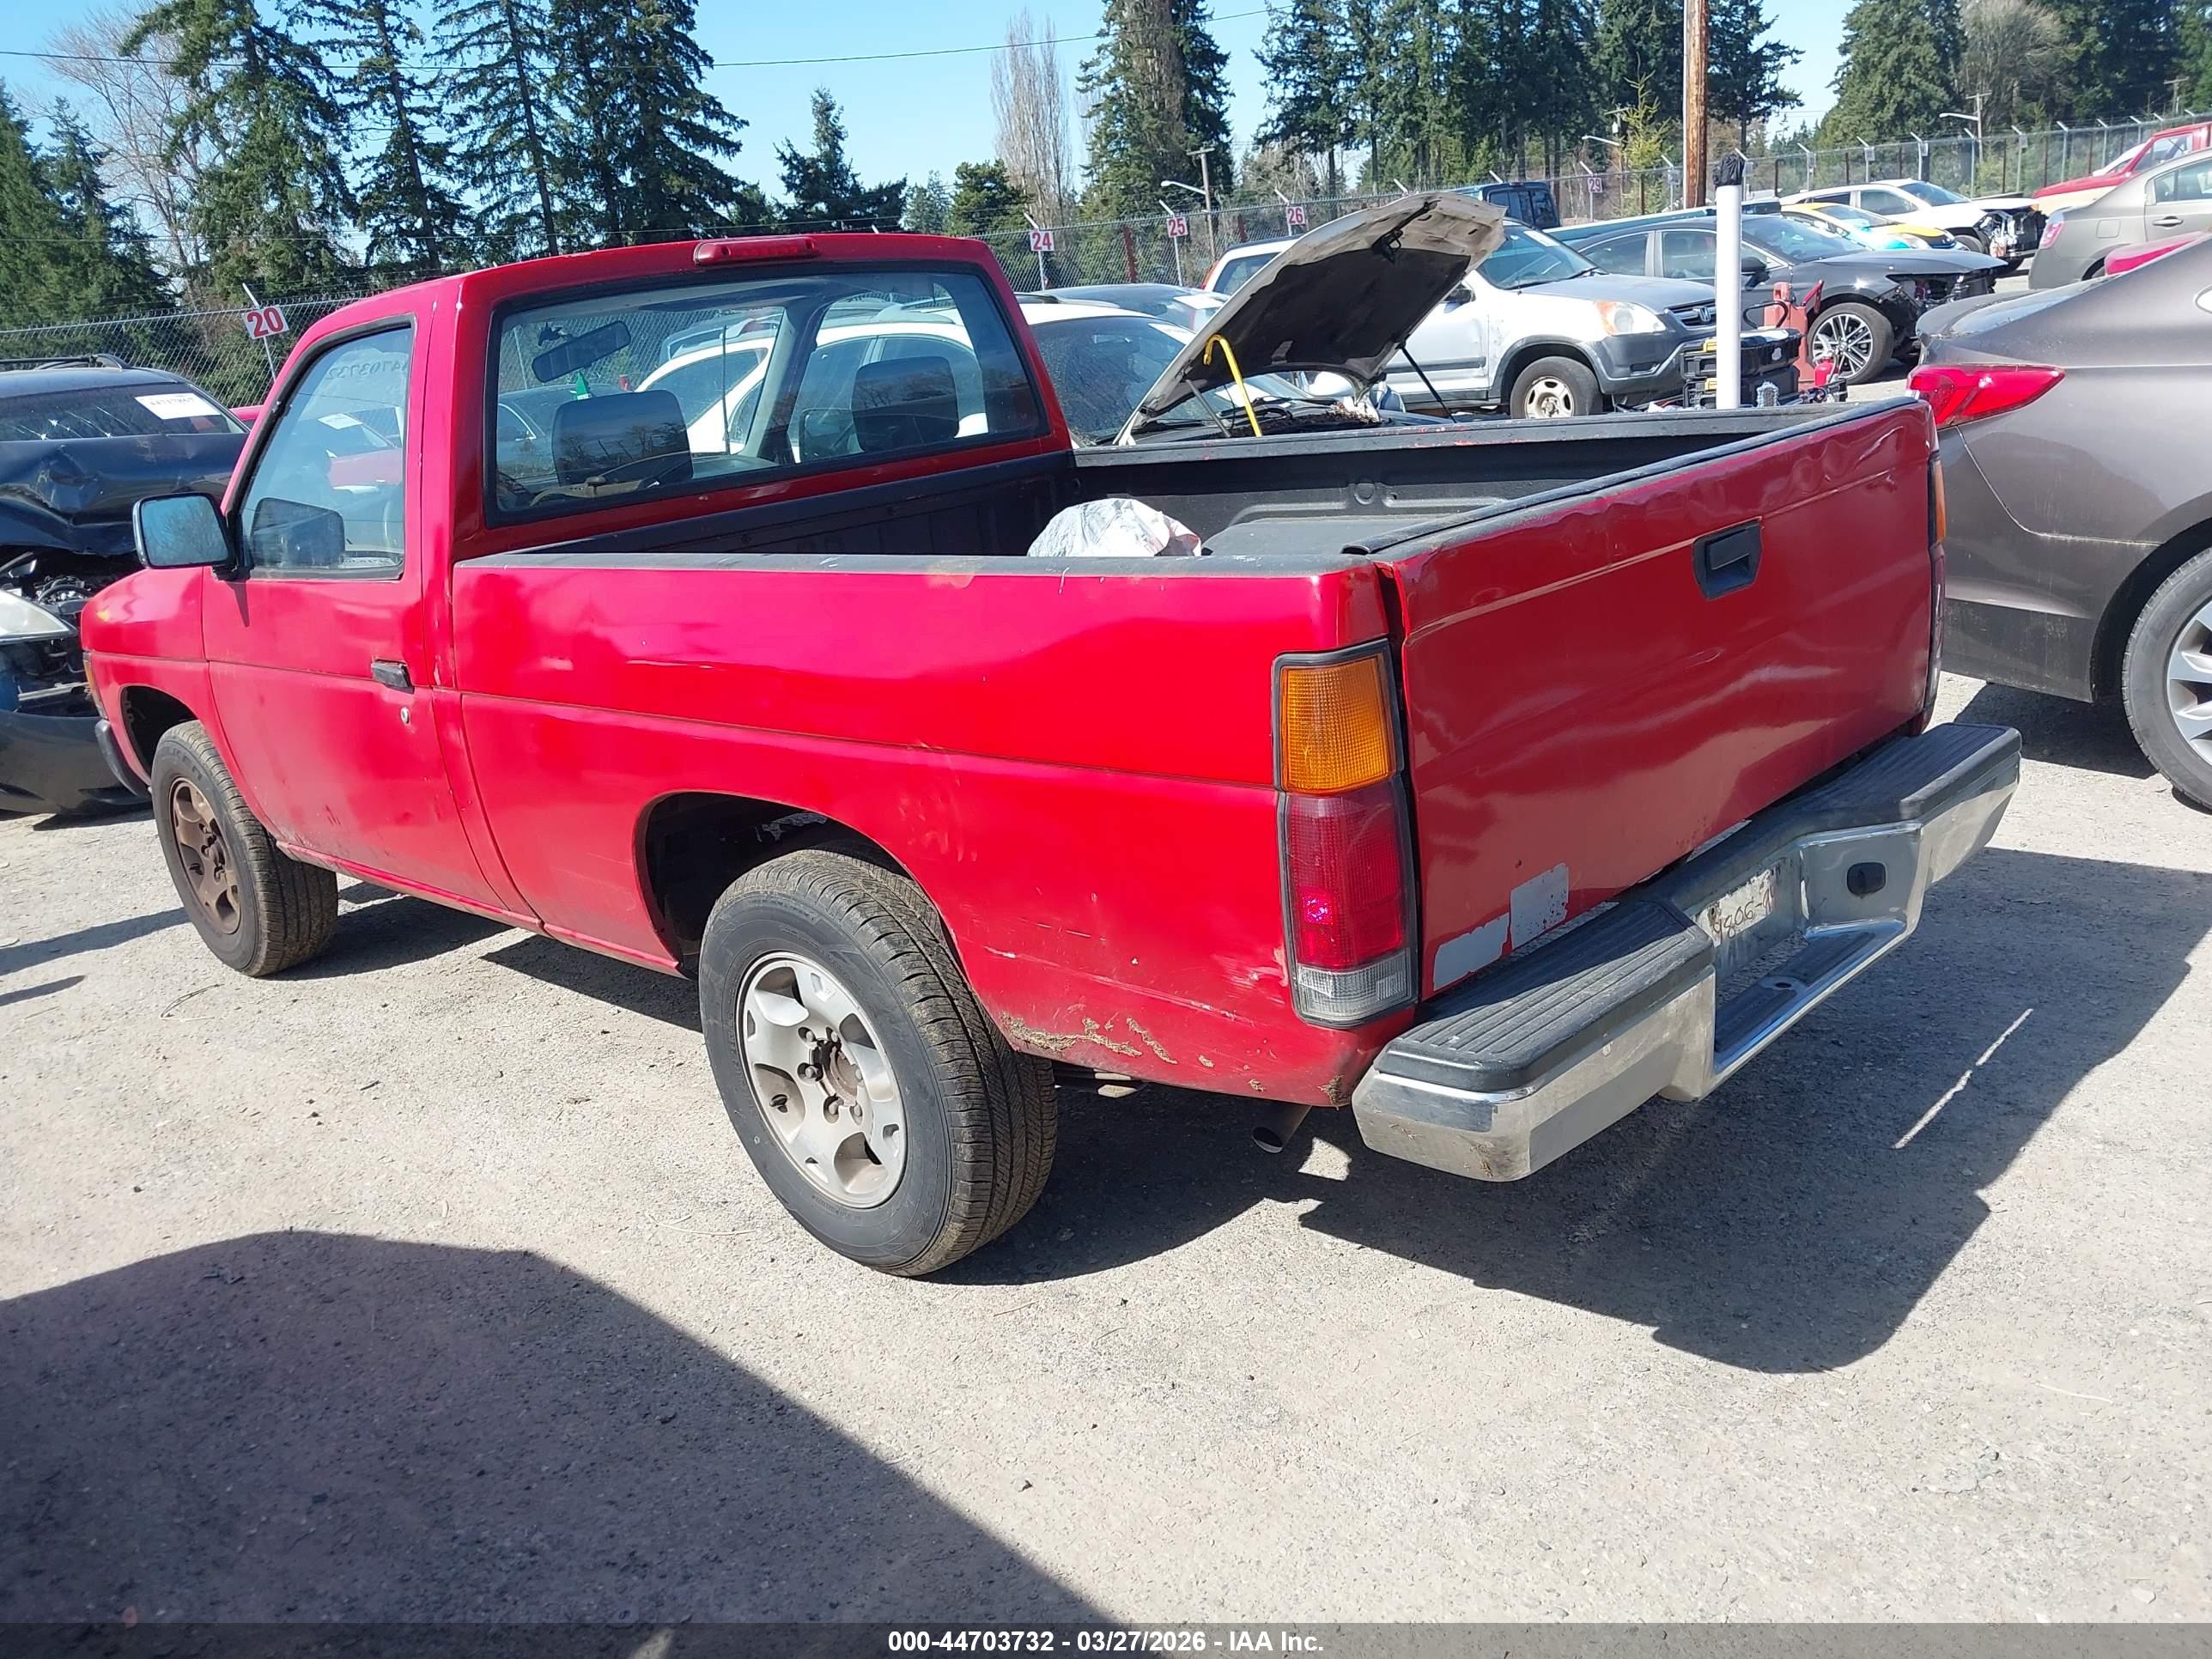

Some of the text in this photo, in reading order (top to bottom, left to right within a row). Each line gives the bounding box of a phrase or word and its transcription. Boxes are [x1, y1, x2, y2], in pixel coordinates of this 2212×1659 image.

[1589, 178, 1601, 192] 29
[1287, 208, 1304, 224] 26
[1169, 218, 1186, 236] 25
[1032, 232, 1052, 251] 24
[247, 307, 284, 337] 20
